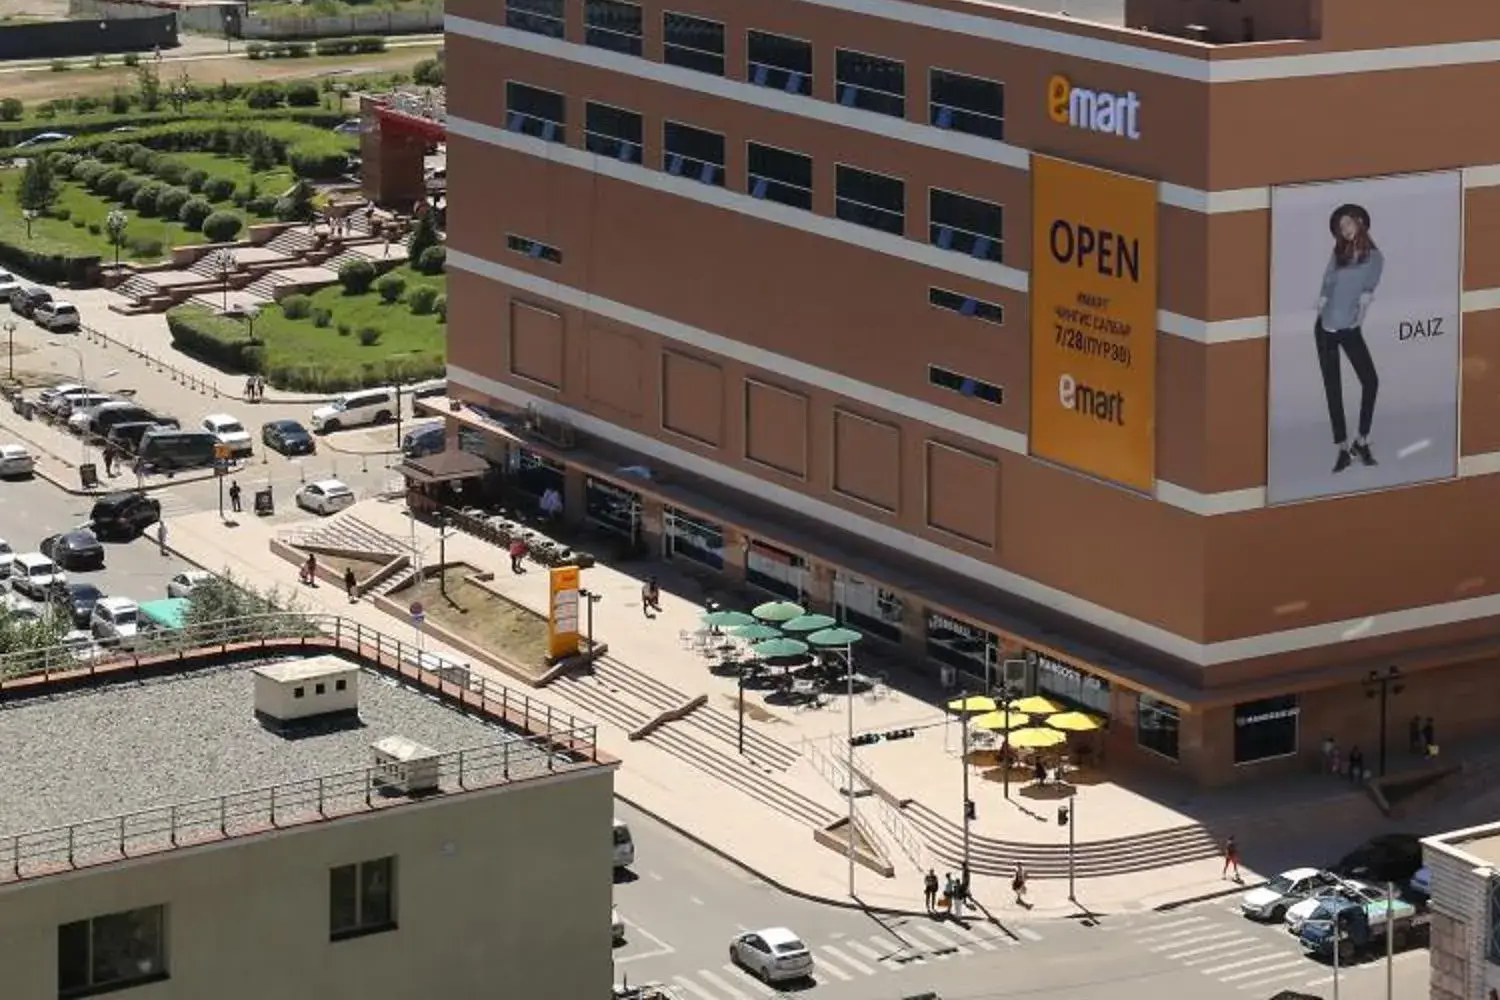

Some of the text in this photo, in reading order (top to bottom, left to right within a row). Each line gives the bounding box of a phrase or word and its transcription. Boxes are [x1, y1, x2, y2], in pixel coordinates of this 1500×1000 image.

[1048, 75, 1141, 139] emart
[1049, 219, 1138, 283] OPEN
[1399, 317, 1444, 340] DAIZ
[1059, 373, 1125, 426] emart
